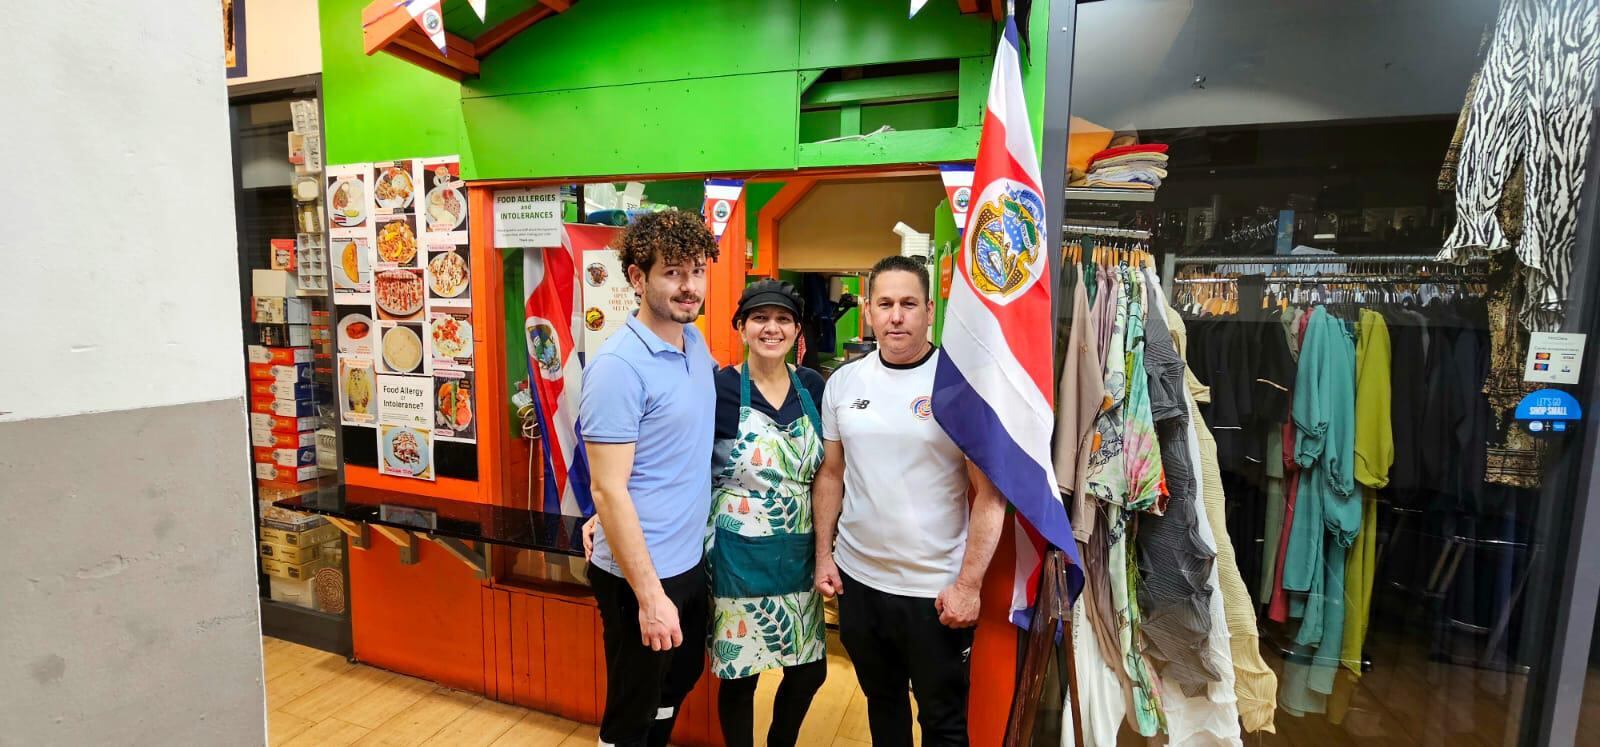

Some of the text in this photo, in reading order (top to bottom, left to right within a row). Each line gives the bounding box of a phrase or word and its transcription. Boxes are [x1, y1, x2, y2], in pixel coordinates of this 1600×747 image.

[497, 194, 556, 204] FOOD ALLERGIES
[500, 211, 553, 220] INTOLERANCES
[383, 385, 424, 397] Food Allergy
[383, 400, 424, 410] Intolerance?
[1536, 397, 1552, 407] LET'S
[1529, 406, 1568, 415] SHOP SMALL
